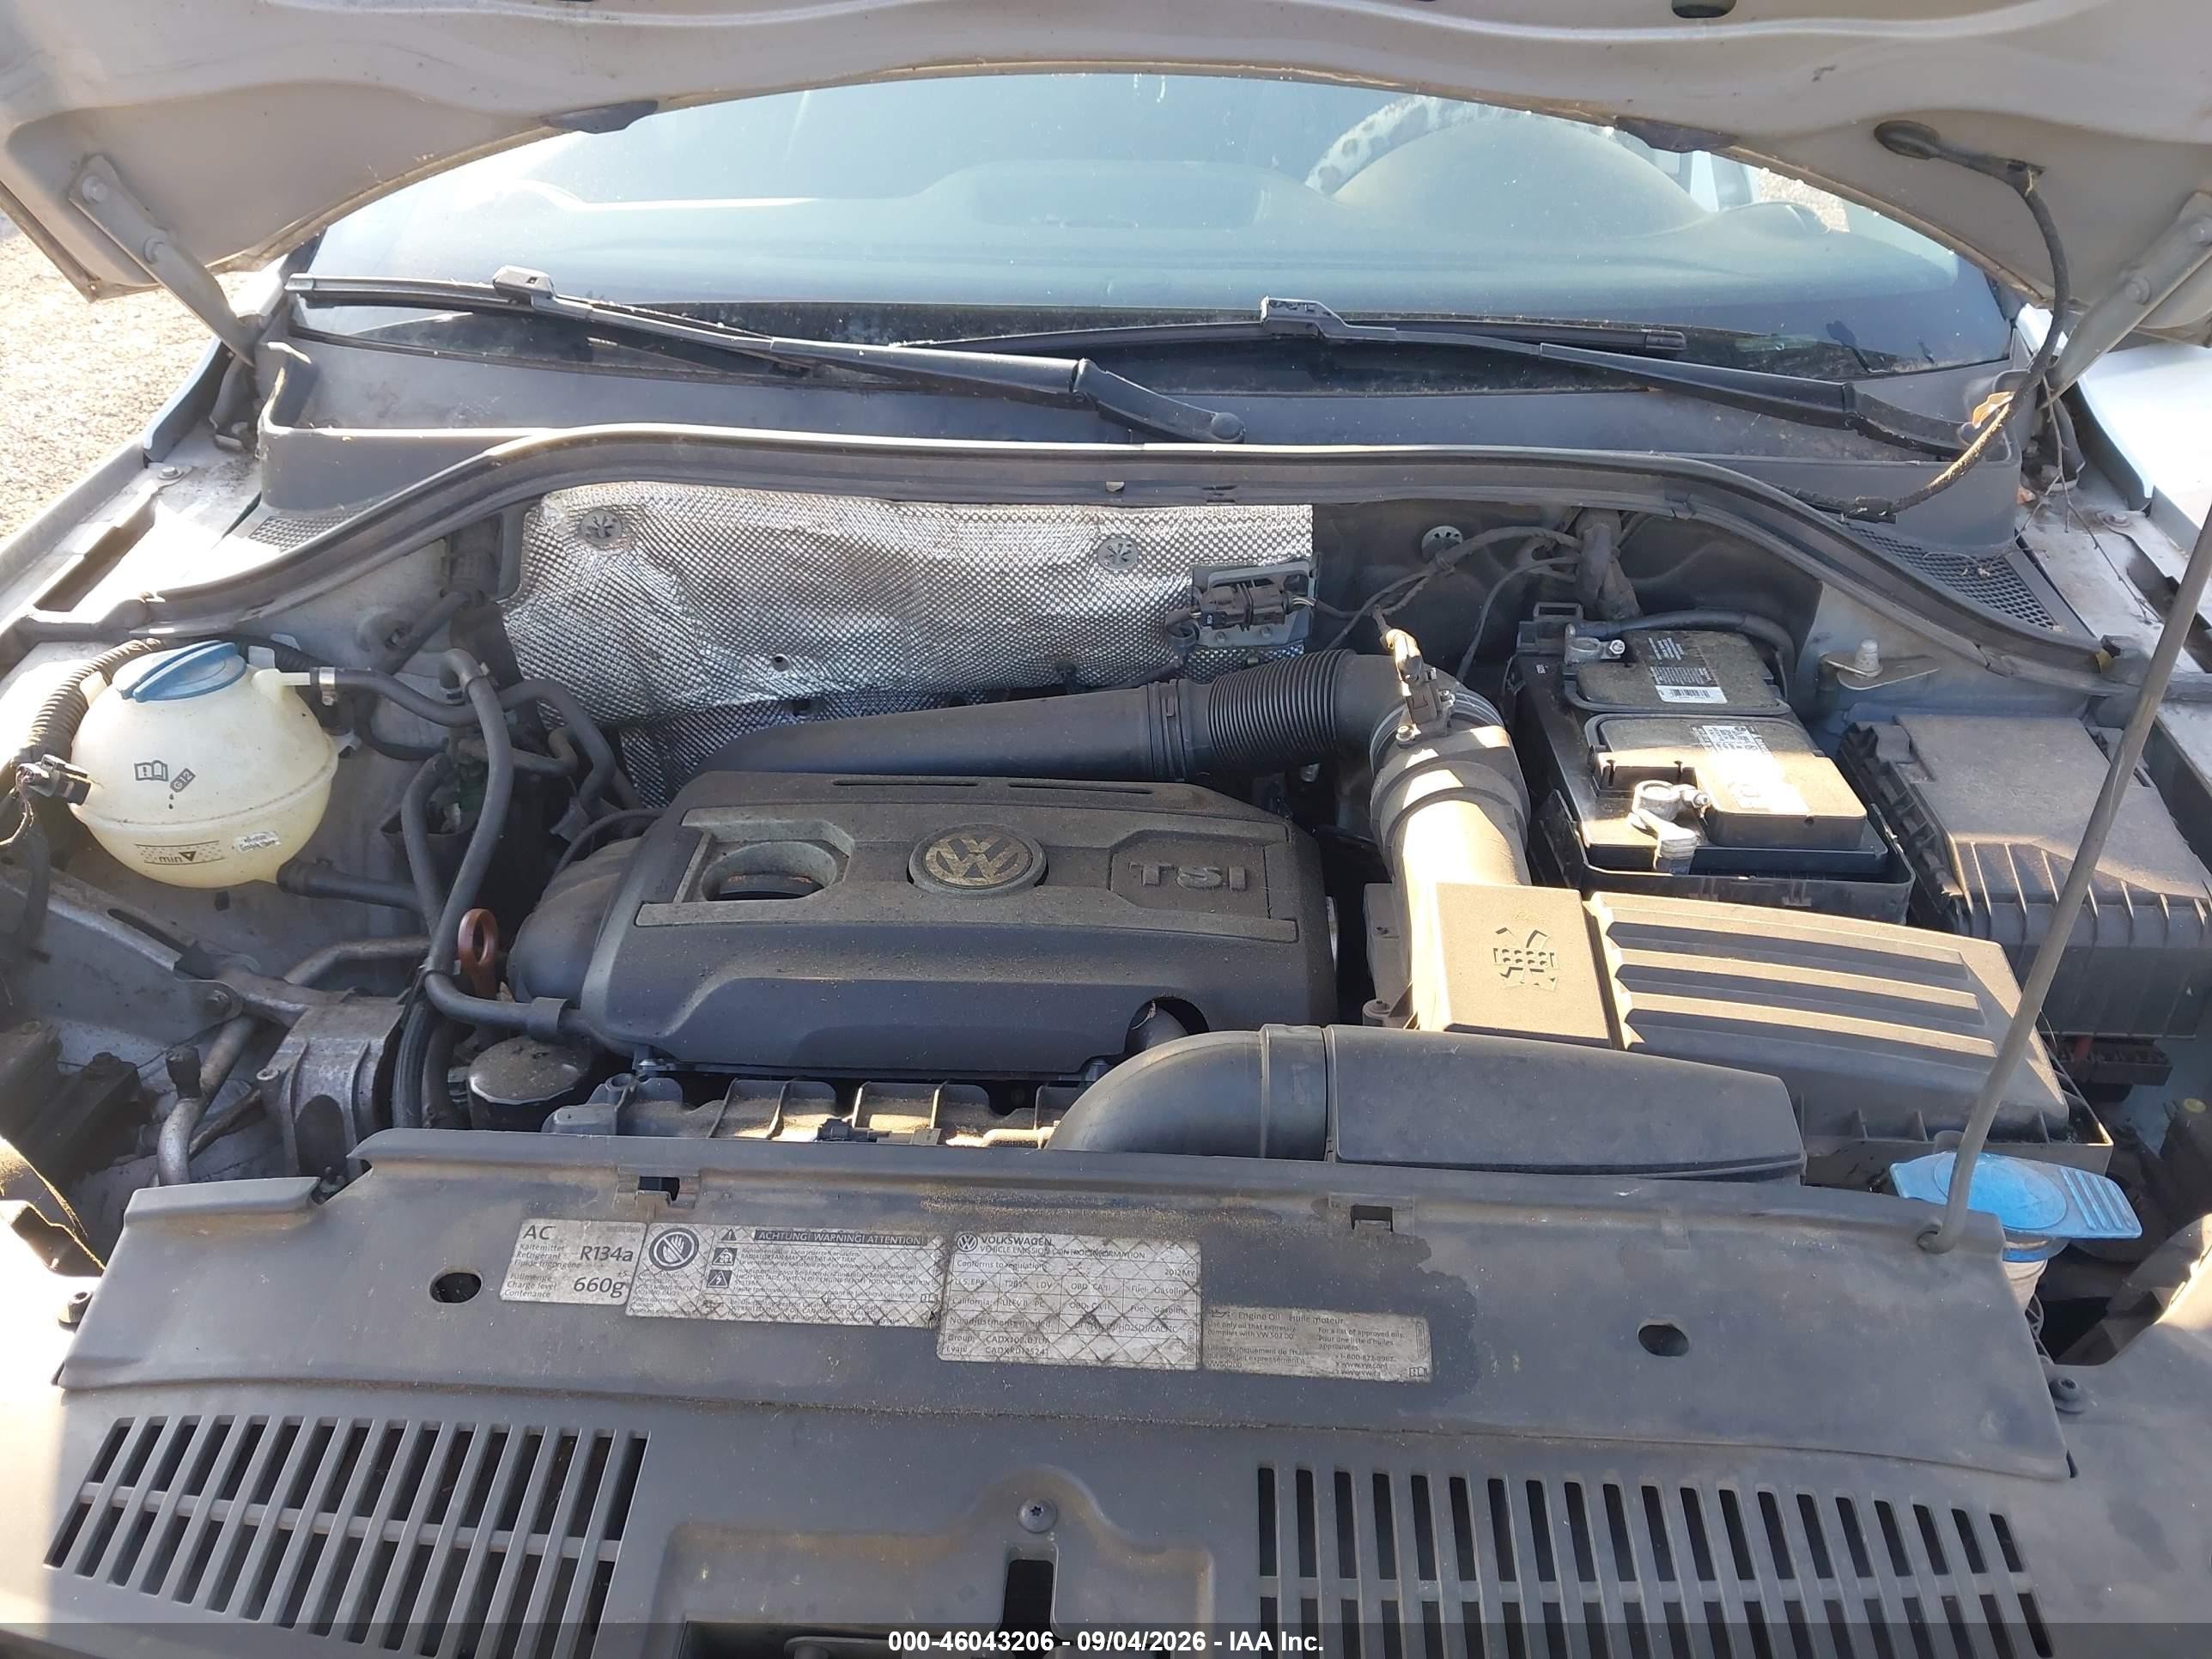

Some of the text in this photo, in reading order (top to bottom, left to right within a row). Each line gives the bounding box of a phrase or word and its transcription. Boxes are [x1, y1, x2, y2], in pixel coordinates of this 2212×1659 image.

[1129, 861, 1247, 892] TSI
[523, 1224, 556, 1240] AC
[814, 1233, 865, 1243] WARNING!
[981, 1236, 1052, 1246] VOLKSWAGEN
[580, 1246, 634, 1262] R134a
[1012, 1246, 1050, 1255] EMISSION
[957, 1260, 994, 1268] Conforms
[507, 1281, 536, 1290] Charge
[573, 1276, 626, 1298] 660g
[504, 1289, 551, 1298] Contenance
[1154, 1286, 1188, 1295] Gasoline
[1153, 1306, 1188, 1314] Gasoline
[1238, 1311, 1267, 1321] Engine
[1268, 1313, 1281, 1321] Oil
[1313, 1317, 1344, 1325] moteur
[1221, 1321, 1236, 1329] only
[1208, 1330, 1237, 1338] complies
[1357, 1330, 1389, 1339] approved
[948, 1335, 975, 1343] Group:
